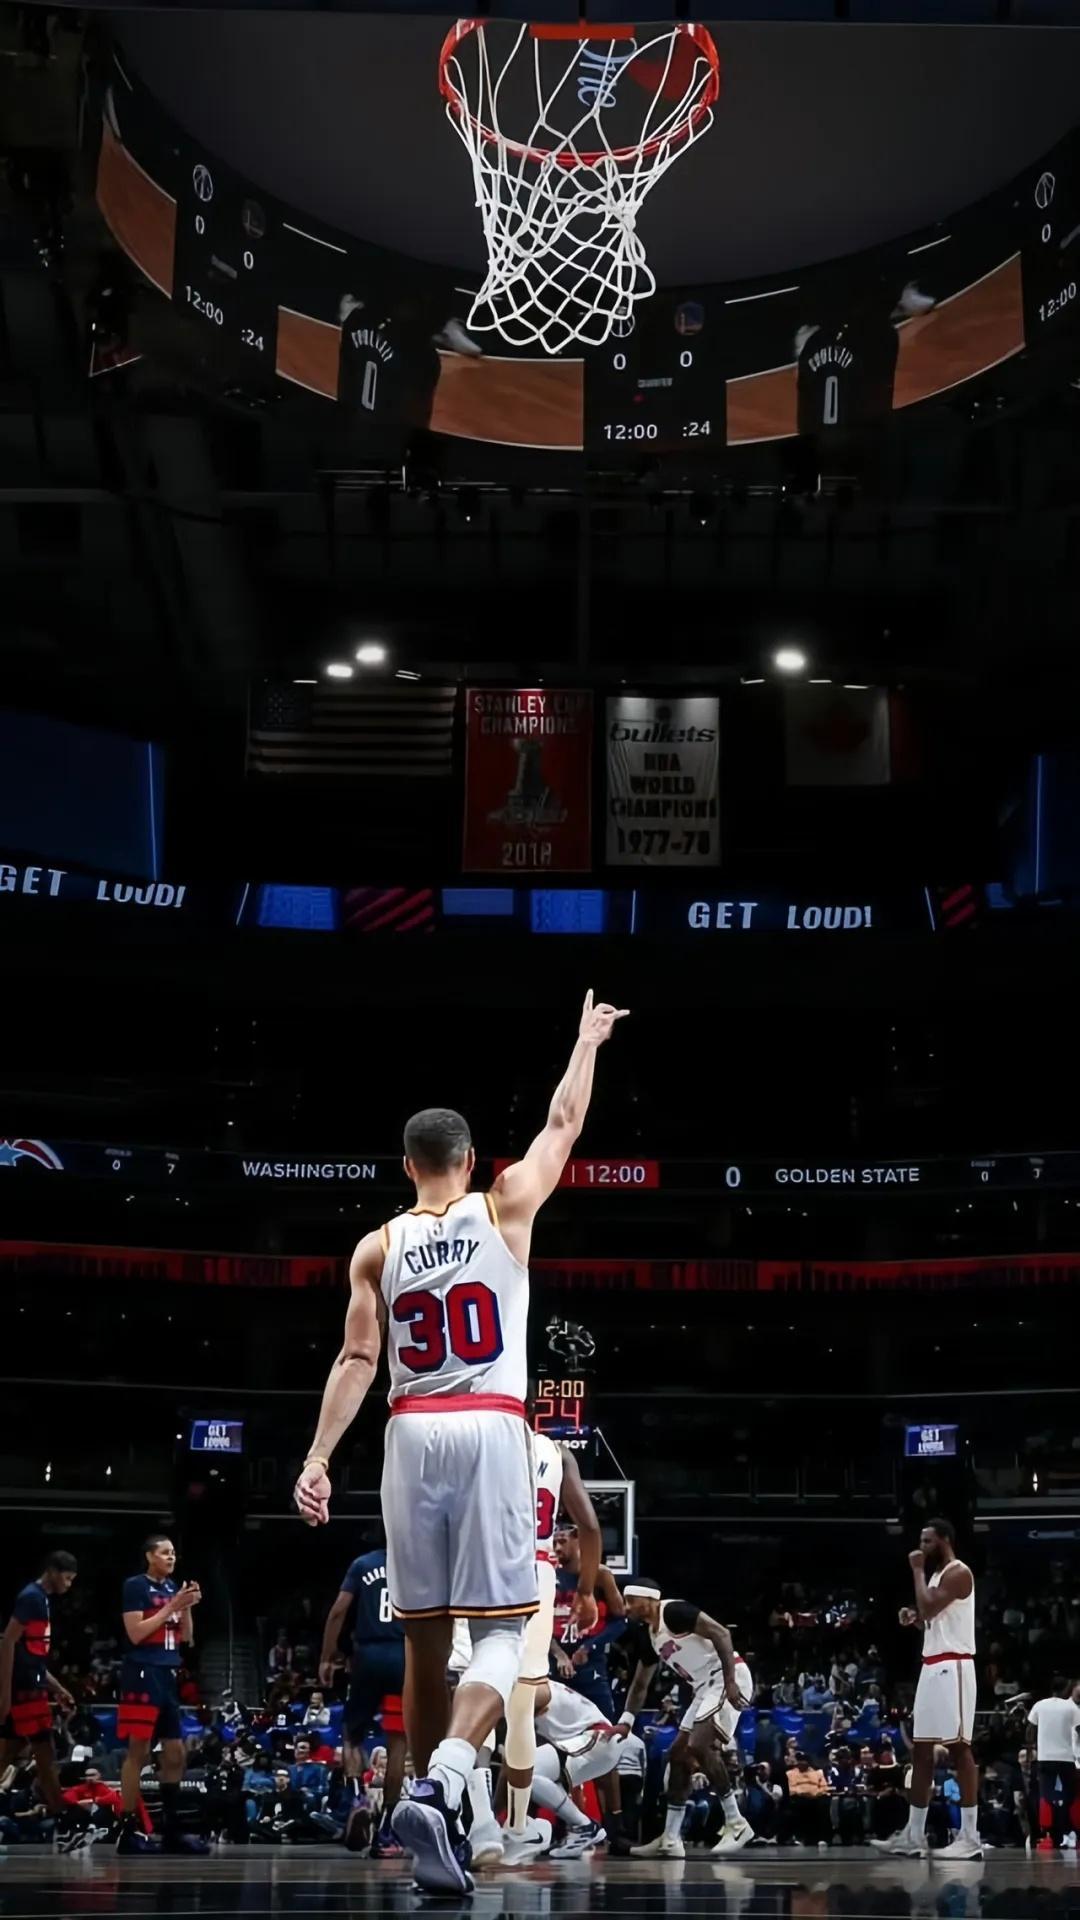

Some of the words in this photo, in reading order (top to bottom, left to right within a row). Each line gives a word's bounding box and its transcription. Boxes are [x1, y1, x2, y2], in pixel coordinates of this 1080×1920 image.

[184, 285, 224, 326] 12:00
[1038, 282, 1077, 322] 12:00
[240, 328, 264, 351] :24
[613, 353, 627, 370] 0
[680, 350, 693, 368] 0
[603, 424, 658, 440] 12:00
[682, 420, 711, 437] :24
[0, 864, 68, 896] GET
[688, 902, 758, 929] GET
[787, 905, 872, 929] LOUD!
[242, 1160, 376, 1180] WASHINGTON
[585, 1164, 646, 1184] 12:00
[725, 1166, 741, 1188] 0
[774, 1168, 855, 1184] GOLDEN
[860, 1167, 920, 1183] STATE
[405, 1239, 480, 1275] CURRY
[392, 1281, 504, 1374] 30
[538, 1380, 585, 1398] 12:00
[535, 1399, 580, 1433] 24
